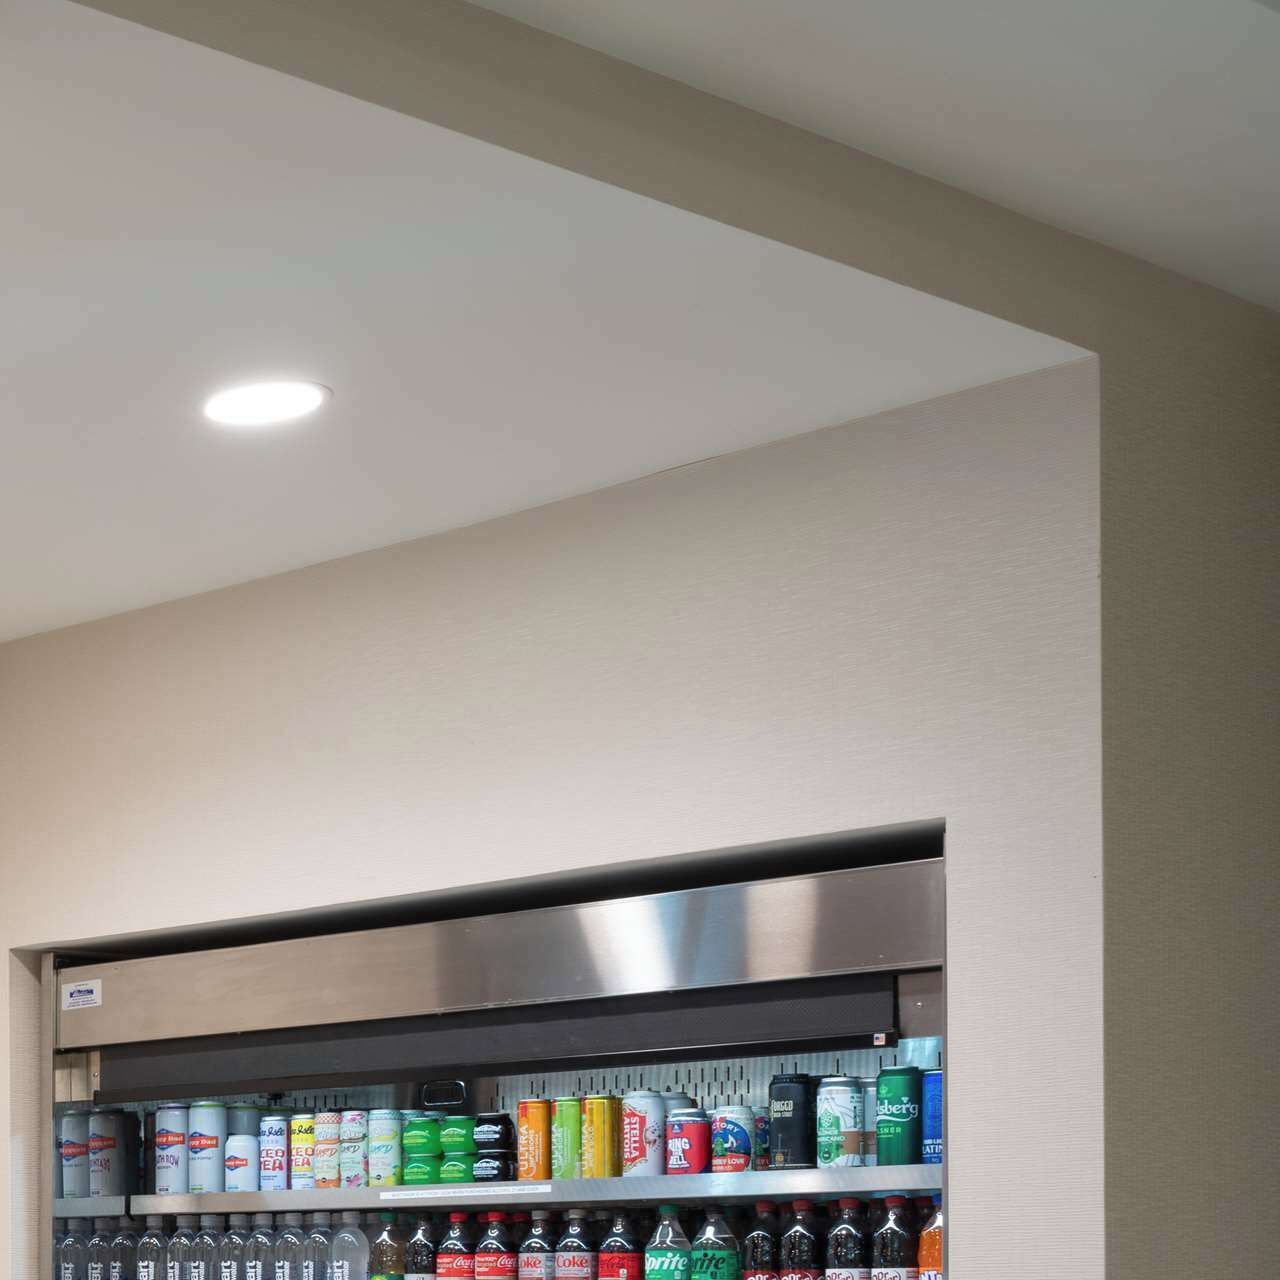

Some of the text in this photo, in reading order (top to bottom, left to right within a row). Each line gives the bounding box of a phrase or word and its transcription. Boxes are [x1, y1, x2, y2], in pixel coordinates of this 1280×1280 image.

[630, 1116, 640, 1158] STELLA
[556, 1257, 588, 1268] Coke
[645, 1253, 688, 1272] Sprite
